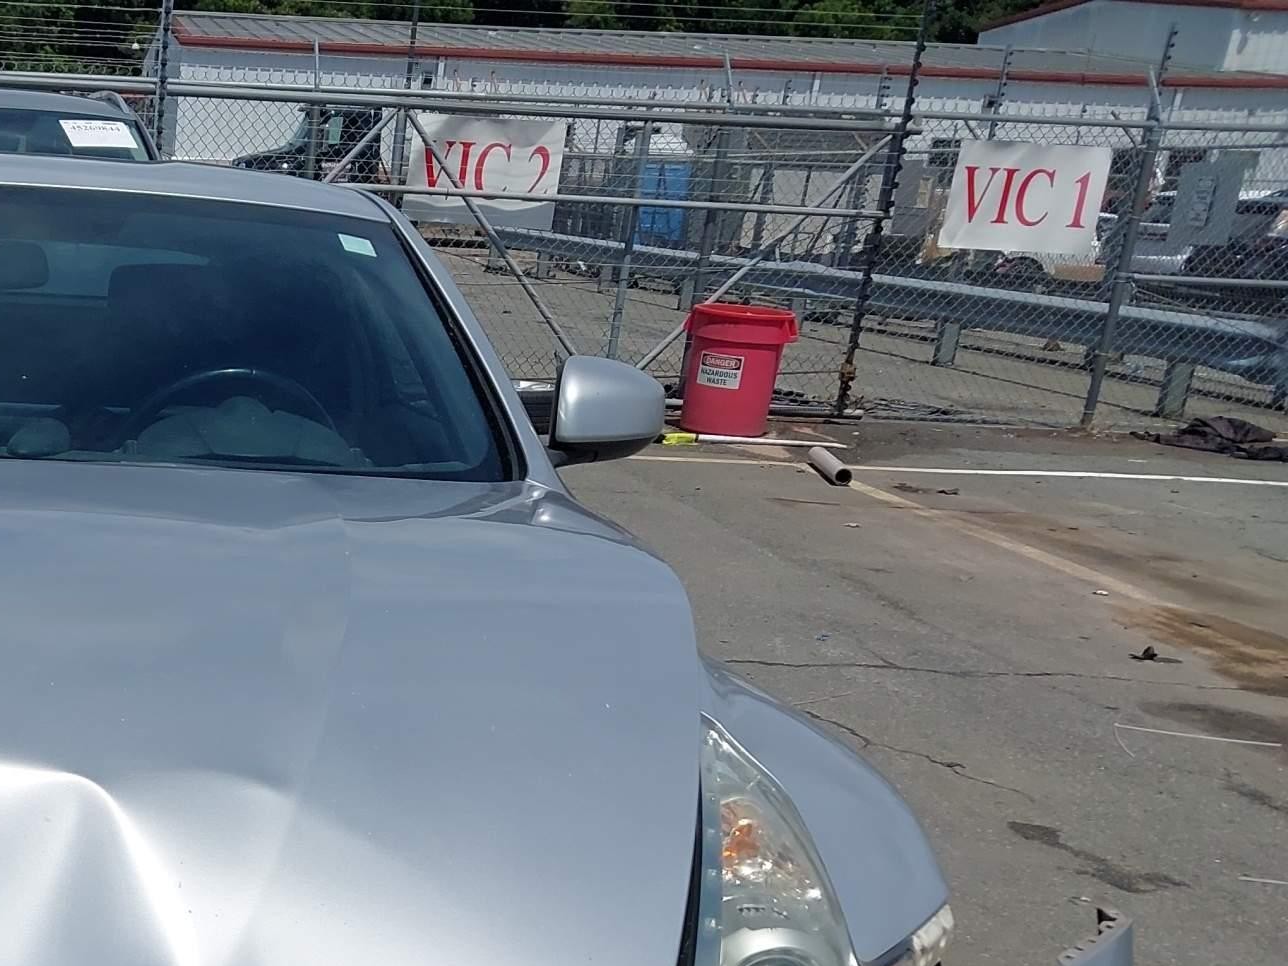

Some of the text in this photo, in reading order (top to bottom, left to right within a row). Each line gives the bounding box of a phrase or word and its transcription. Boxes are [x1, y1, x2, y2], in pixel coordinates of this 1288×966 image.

[527, 144, 551, 197] 2
[964, 166, 1092, 229] VIC 1
[700, 367, 738, 379] HAZARDOUS
[706, 376, 728, 386] WASTE
